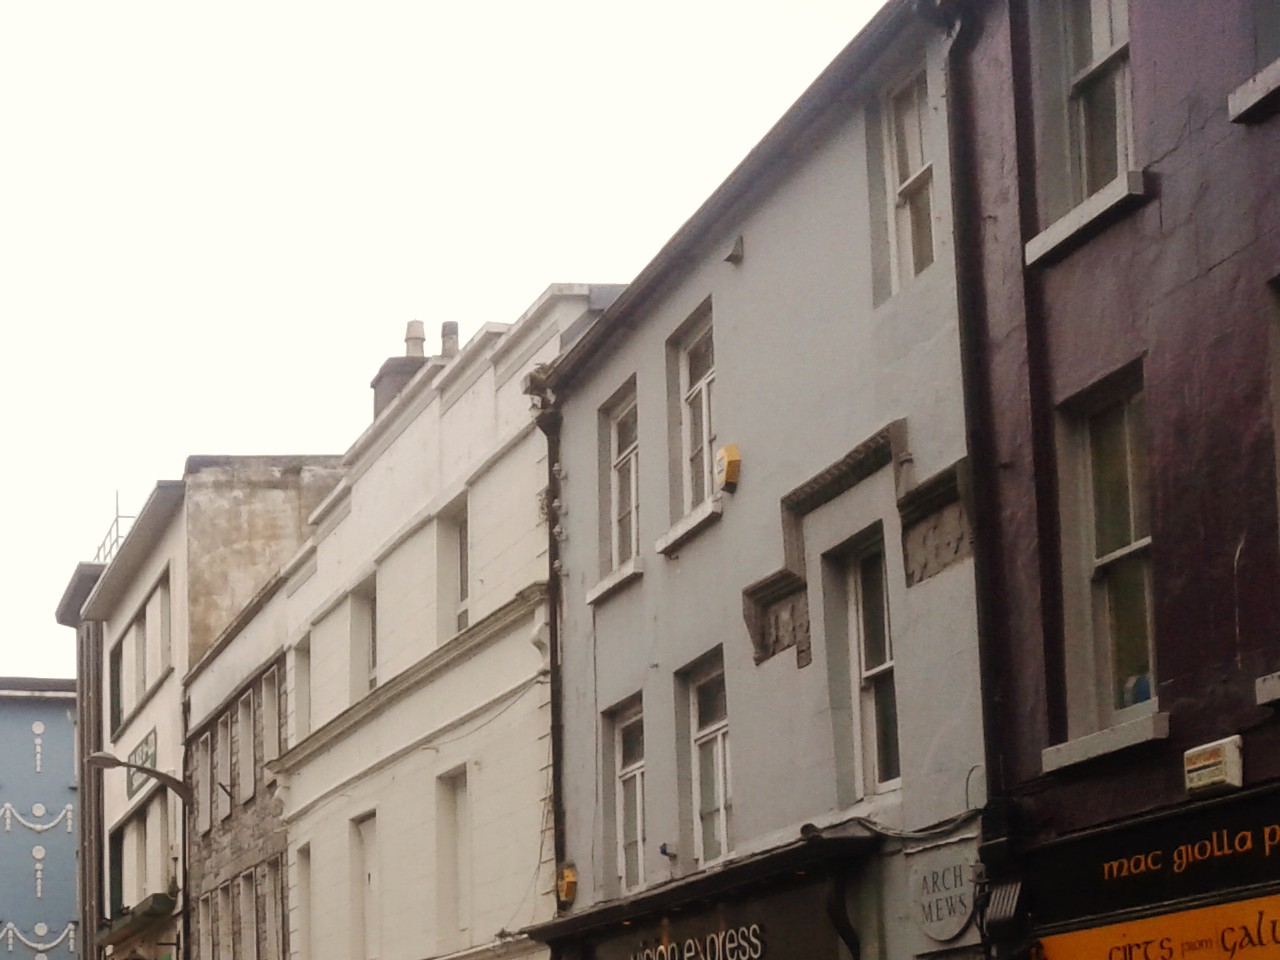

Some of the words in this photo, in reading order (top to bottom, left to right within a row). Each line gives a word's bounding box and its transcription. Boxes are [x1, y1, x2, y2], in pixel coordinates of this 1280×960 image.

[1103, 851, 1163, 880] mac
[1173, 828, 1253, 873] giolla
[922, 864, 964, 896] ARCH
[921, 894, 967, 925] MEWS
